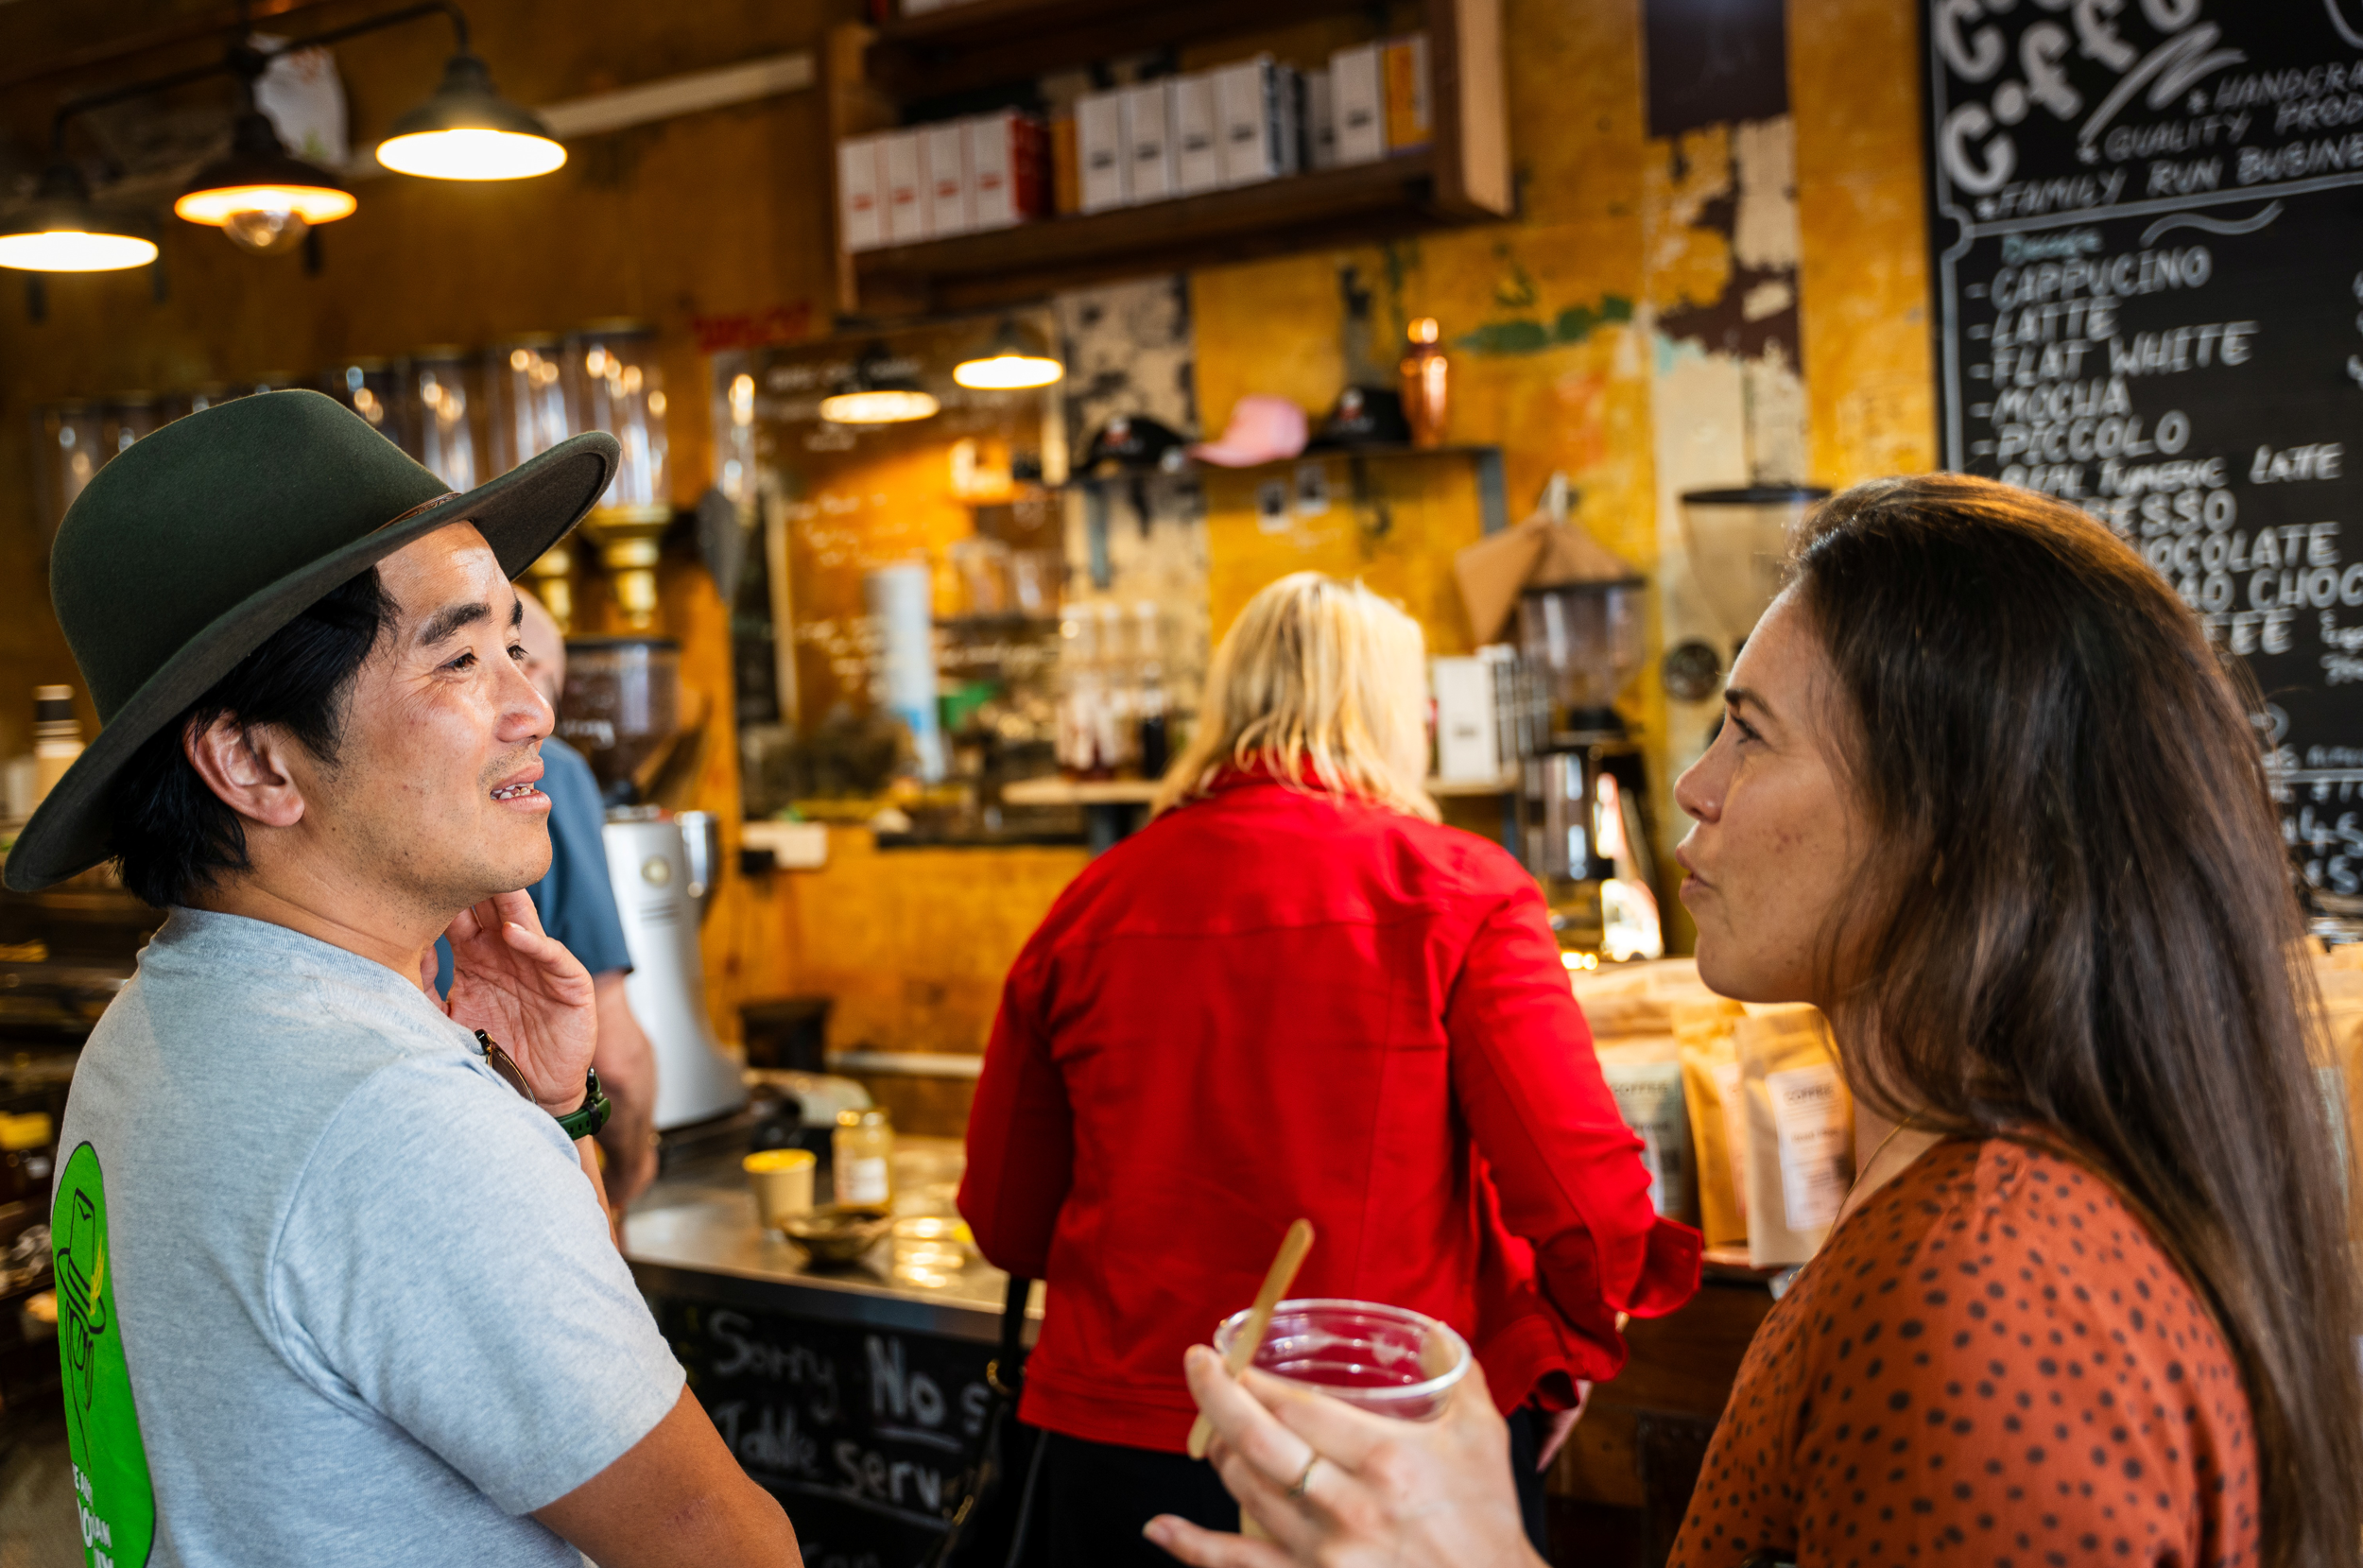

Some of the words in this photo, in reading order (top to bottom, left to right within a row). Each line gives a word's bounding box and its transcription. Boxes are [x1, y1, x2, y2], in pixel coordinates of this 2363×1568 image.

[1997, 168, 2127, 217] FAMILY
[2147, 154, 2224, 196] RUN
[1991, 245, 2212, 312] CAPPUCINO
[1992, 295, 2123, 349] LATTE
[1992, 337, 2096, 389] FLAT
[2109, 319, 2263, 376] WHITE
[1990, 375, 2132, 425] MOCHA
[1995, 408, 2191, 467] PICCOLO
[2146, 520, 2342, 577] OCOLATE
[706, 1308, 839, 1426] Sorry
[864, 1332, 945, 1428] No
